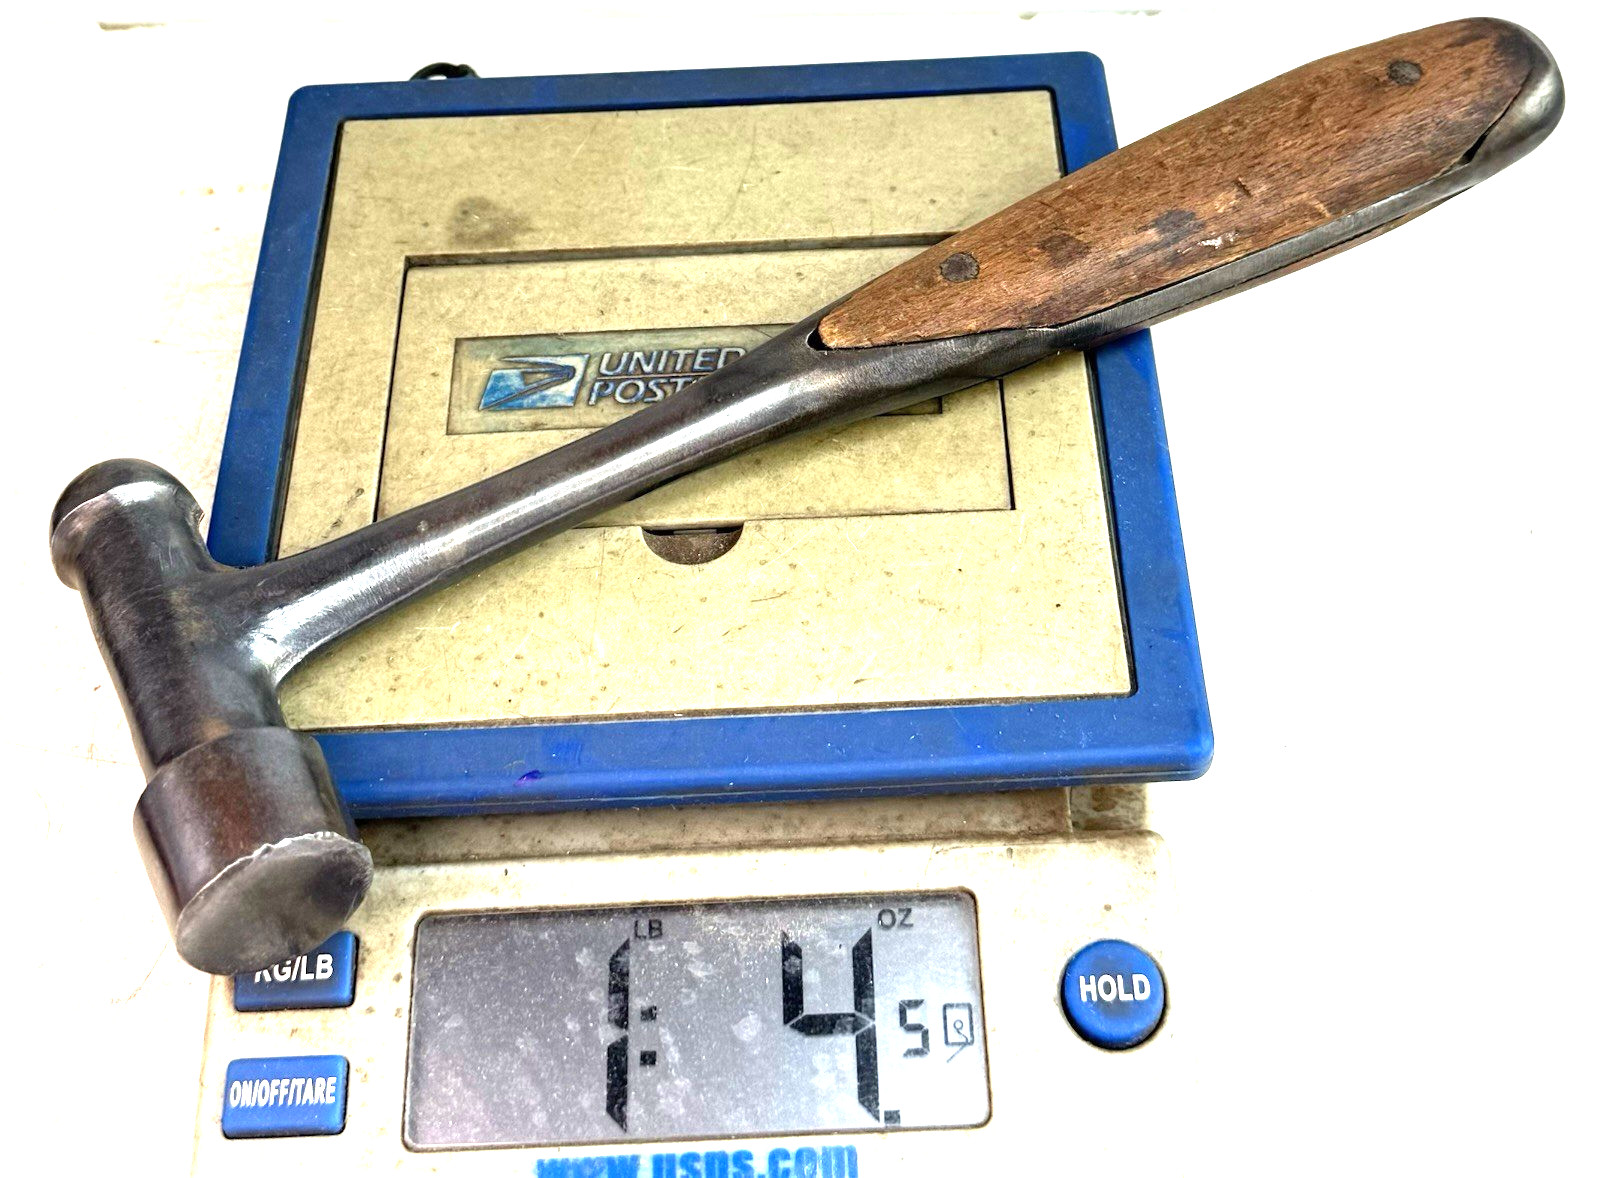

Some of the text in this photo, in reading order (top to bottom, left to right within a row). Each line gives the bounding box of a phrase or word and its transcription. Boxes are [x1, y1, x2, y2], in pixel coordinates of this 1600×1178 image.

[599, 347, 748, 376] UNITED
[588, 376, 700, 406] POST
[633, 918, 663, 940] LB
[877, 907, 914, 930] OZ
[1079, 972, 1151, 1003] HOLD
[229, 1076, 337, 1108] ON/OFF/TARE
[535, 1145, 859, 1178] wwwusps.com
